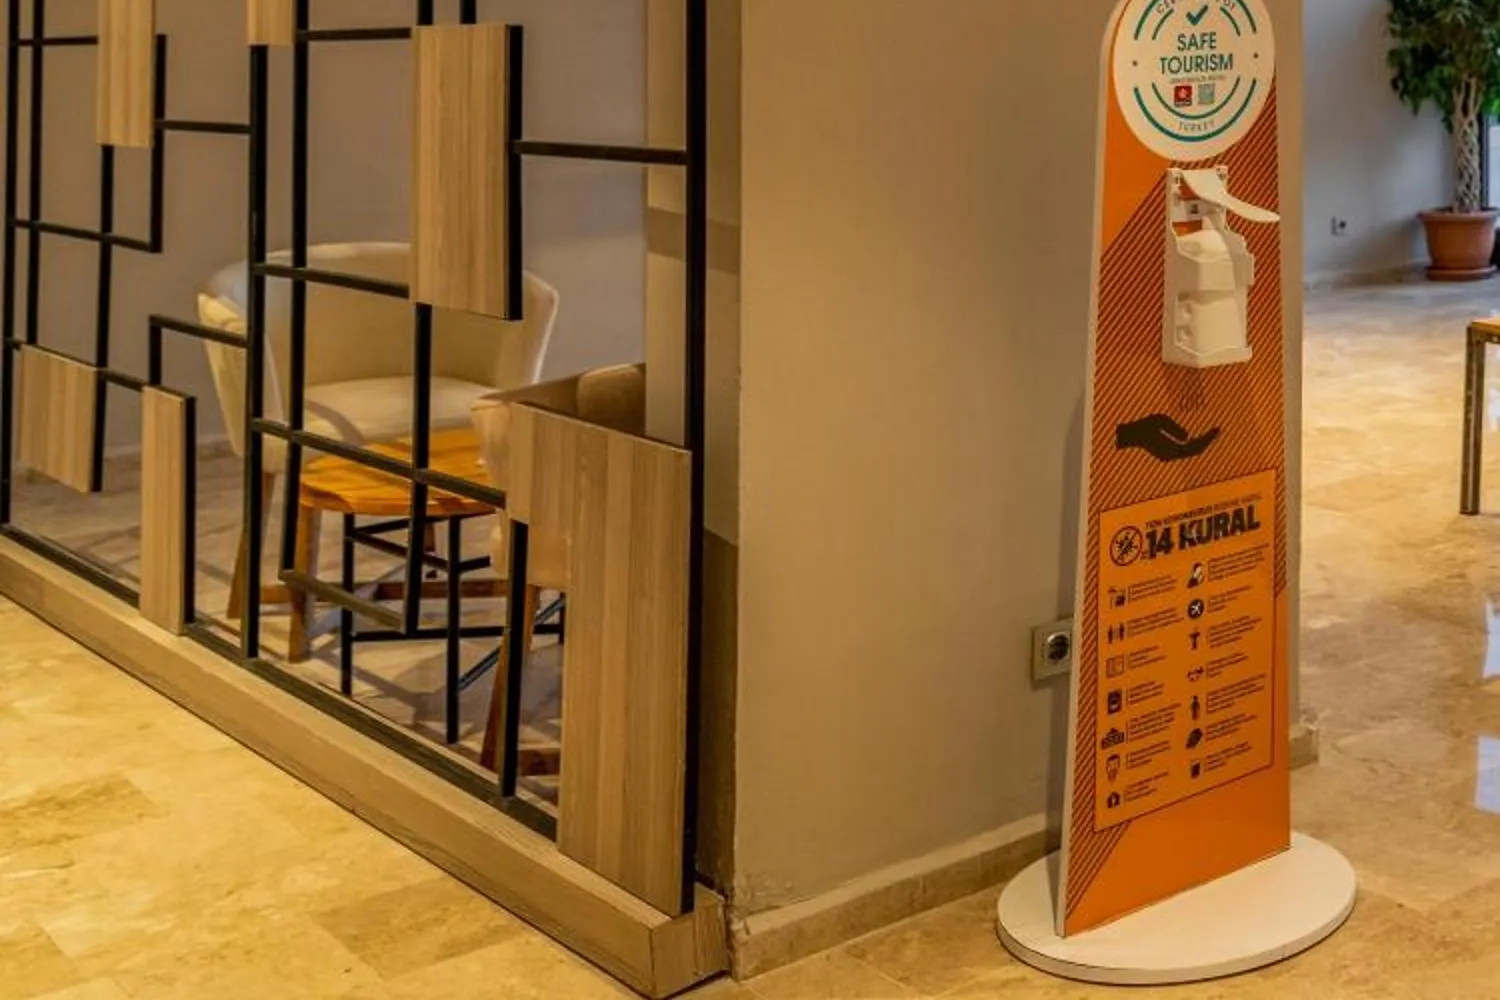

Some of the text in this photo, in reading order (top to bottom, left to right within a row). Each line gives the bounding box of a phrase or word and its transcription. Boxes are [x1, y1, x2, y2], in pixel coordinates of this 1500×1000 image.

[1177, 31, 1217, 51] SAFE
[1159, 52, 1234, 75] TOURISM
[1145, 527, 1175, 559] 14
[1179, 504, 1261, 551] KURAL
